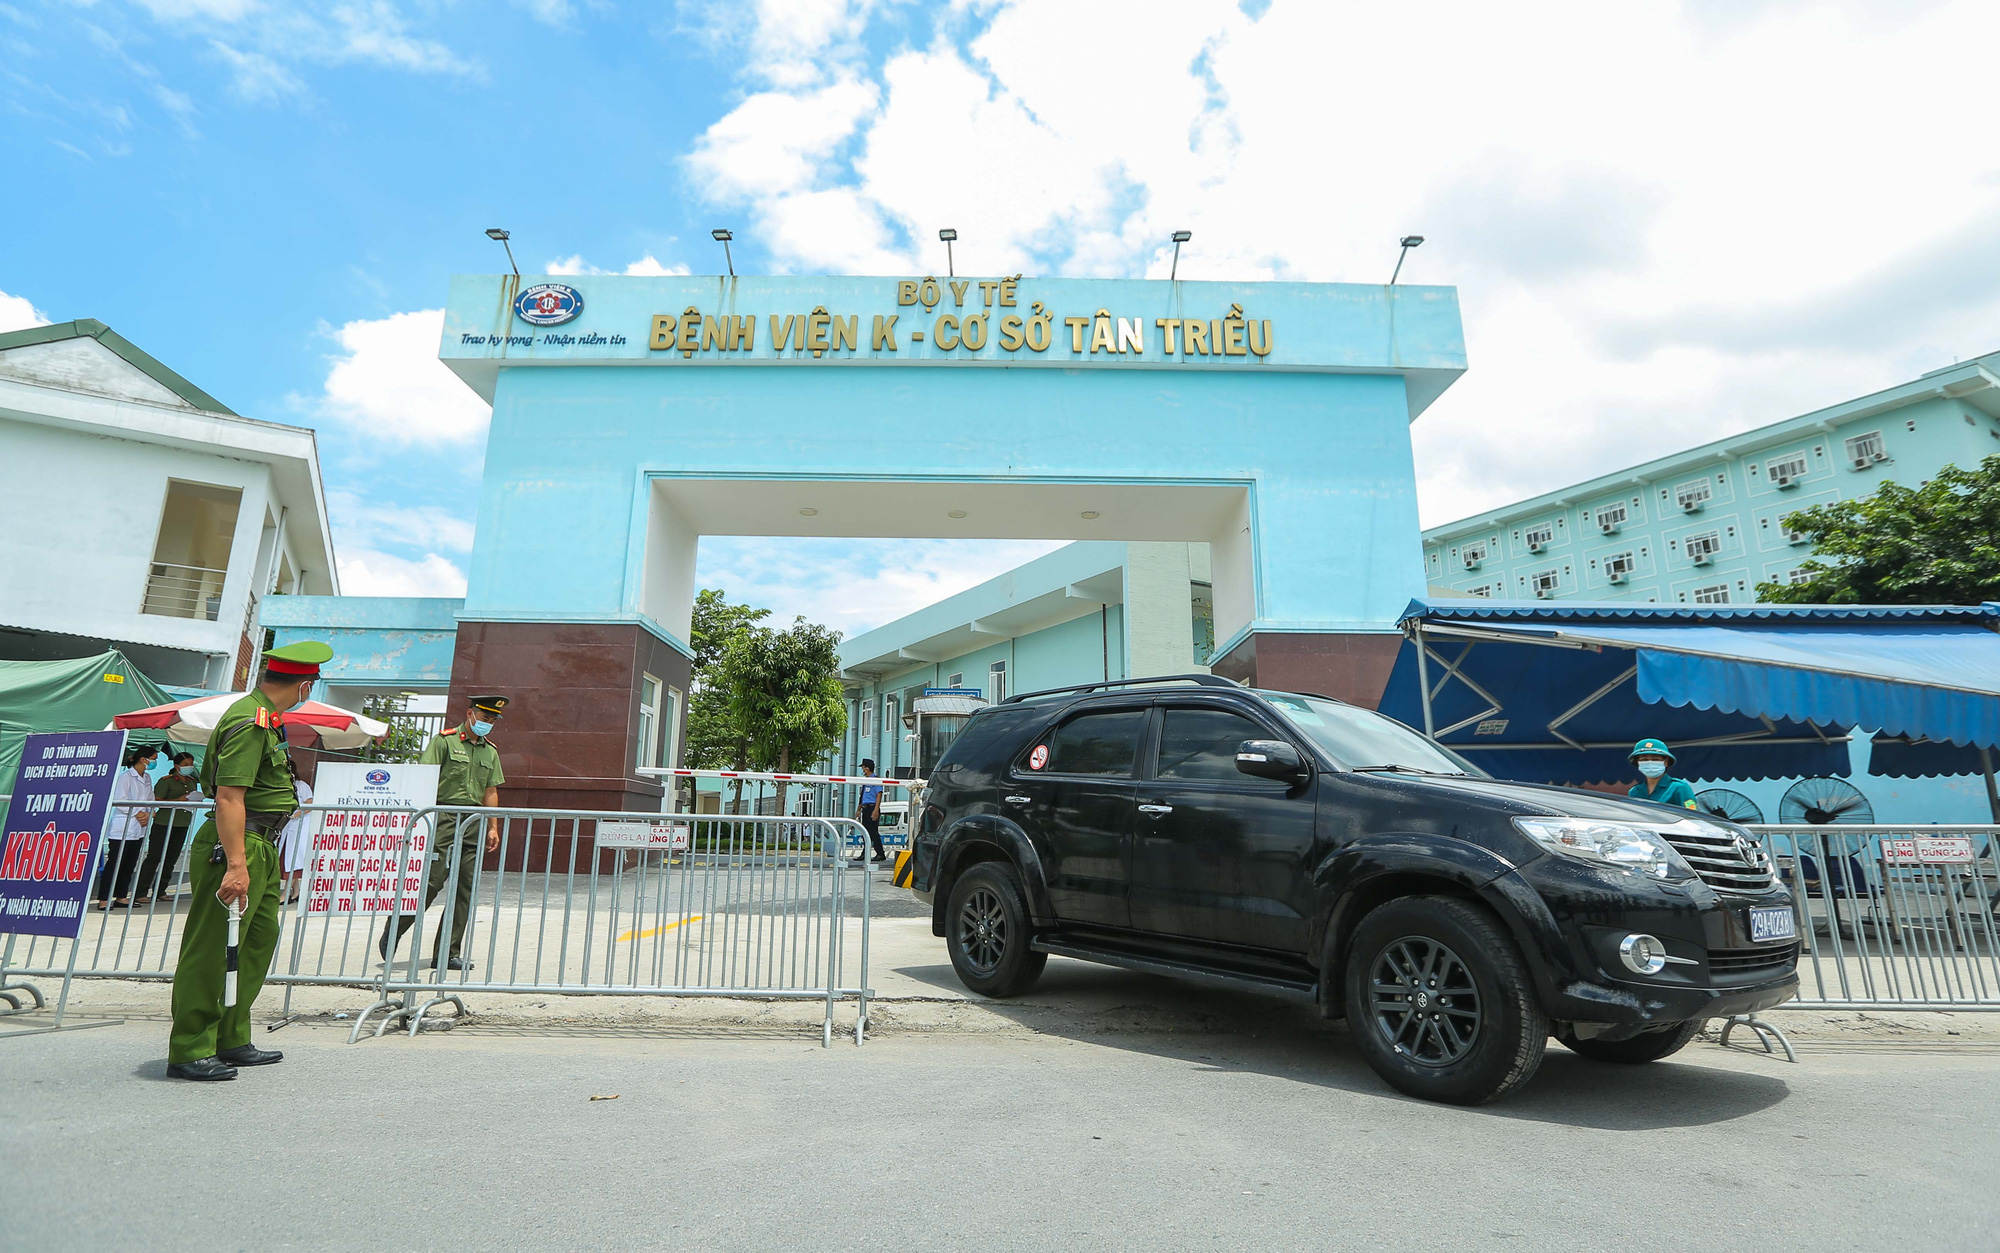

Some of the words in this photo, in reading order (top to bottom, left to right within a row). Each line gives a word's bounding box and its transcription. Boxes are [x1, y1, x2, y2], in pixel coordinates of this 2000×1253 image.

[898, 276, 940, 313] BỘ
[949, 281, 969, 306] Y
[979, 273, 1022, 307] TẾ
[461, 333, 485, 345] Trao
[487, 333, 503, 346] hy
[505, 335, 533, 347] vọng
[543, 333, 575, 347] Nhận
[578, 331, 607, 345] niềm
[609, 334, 626, 345] tin
[649, 306, 756, 358] BỆNH
[769, 306, 857, 358] VIỆN
[872, 315, 899, 351] K
[912, 331, 924, 342] -
[934, 310, 990, 351] CƠ
[999, 301, 1053, 352] SỞ
[1065, 308, 1143, 354] TÂN
[1156, 303, 1273, 356] TRIỀU
[42, 746, 55, 760] DO
[56, 743, 76, 759] TÌNH
[76, 742, 98, 758] HÌNH
[24, 765, 45, 781] DỊCH
[45, 762, 69, 781] BỆNH
[69, 763, 108, 777] COVID-19
[25, 793, 57, 816] TẠM
[59, 788, 93, 812] THỜI
[404, 799, 413, 807] K
[312, 829, 350, 850] PHÒNG
[351, 834, 377, 854] DỊCH
[379, 834, 425, 851] COVI-19
[629, 834, 646, 843] LẠI
[649, 833, 668, 843] ỪNG
[0, 821, 91, 882] KHÔNG
[329, 859, 355, 875] NGHỊ
[360, 856, 380, 872] CÁC
[406, 856, 422, 872] ÀO
[339, 876, 363, 895] VIỆN
[365, 874, 390, 891] PHẢI
[6, 894, 31, 919] NHẬN
[30, 895, 54, 920] BỆNH
[53, 896, 80, 918] NHÂN
[401, 898, 418, 911] TIN
